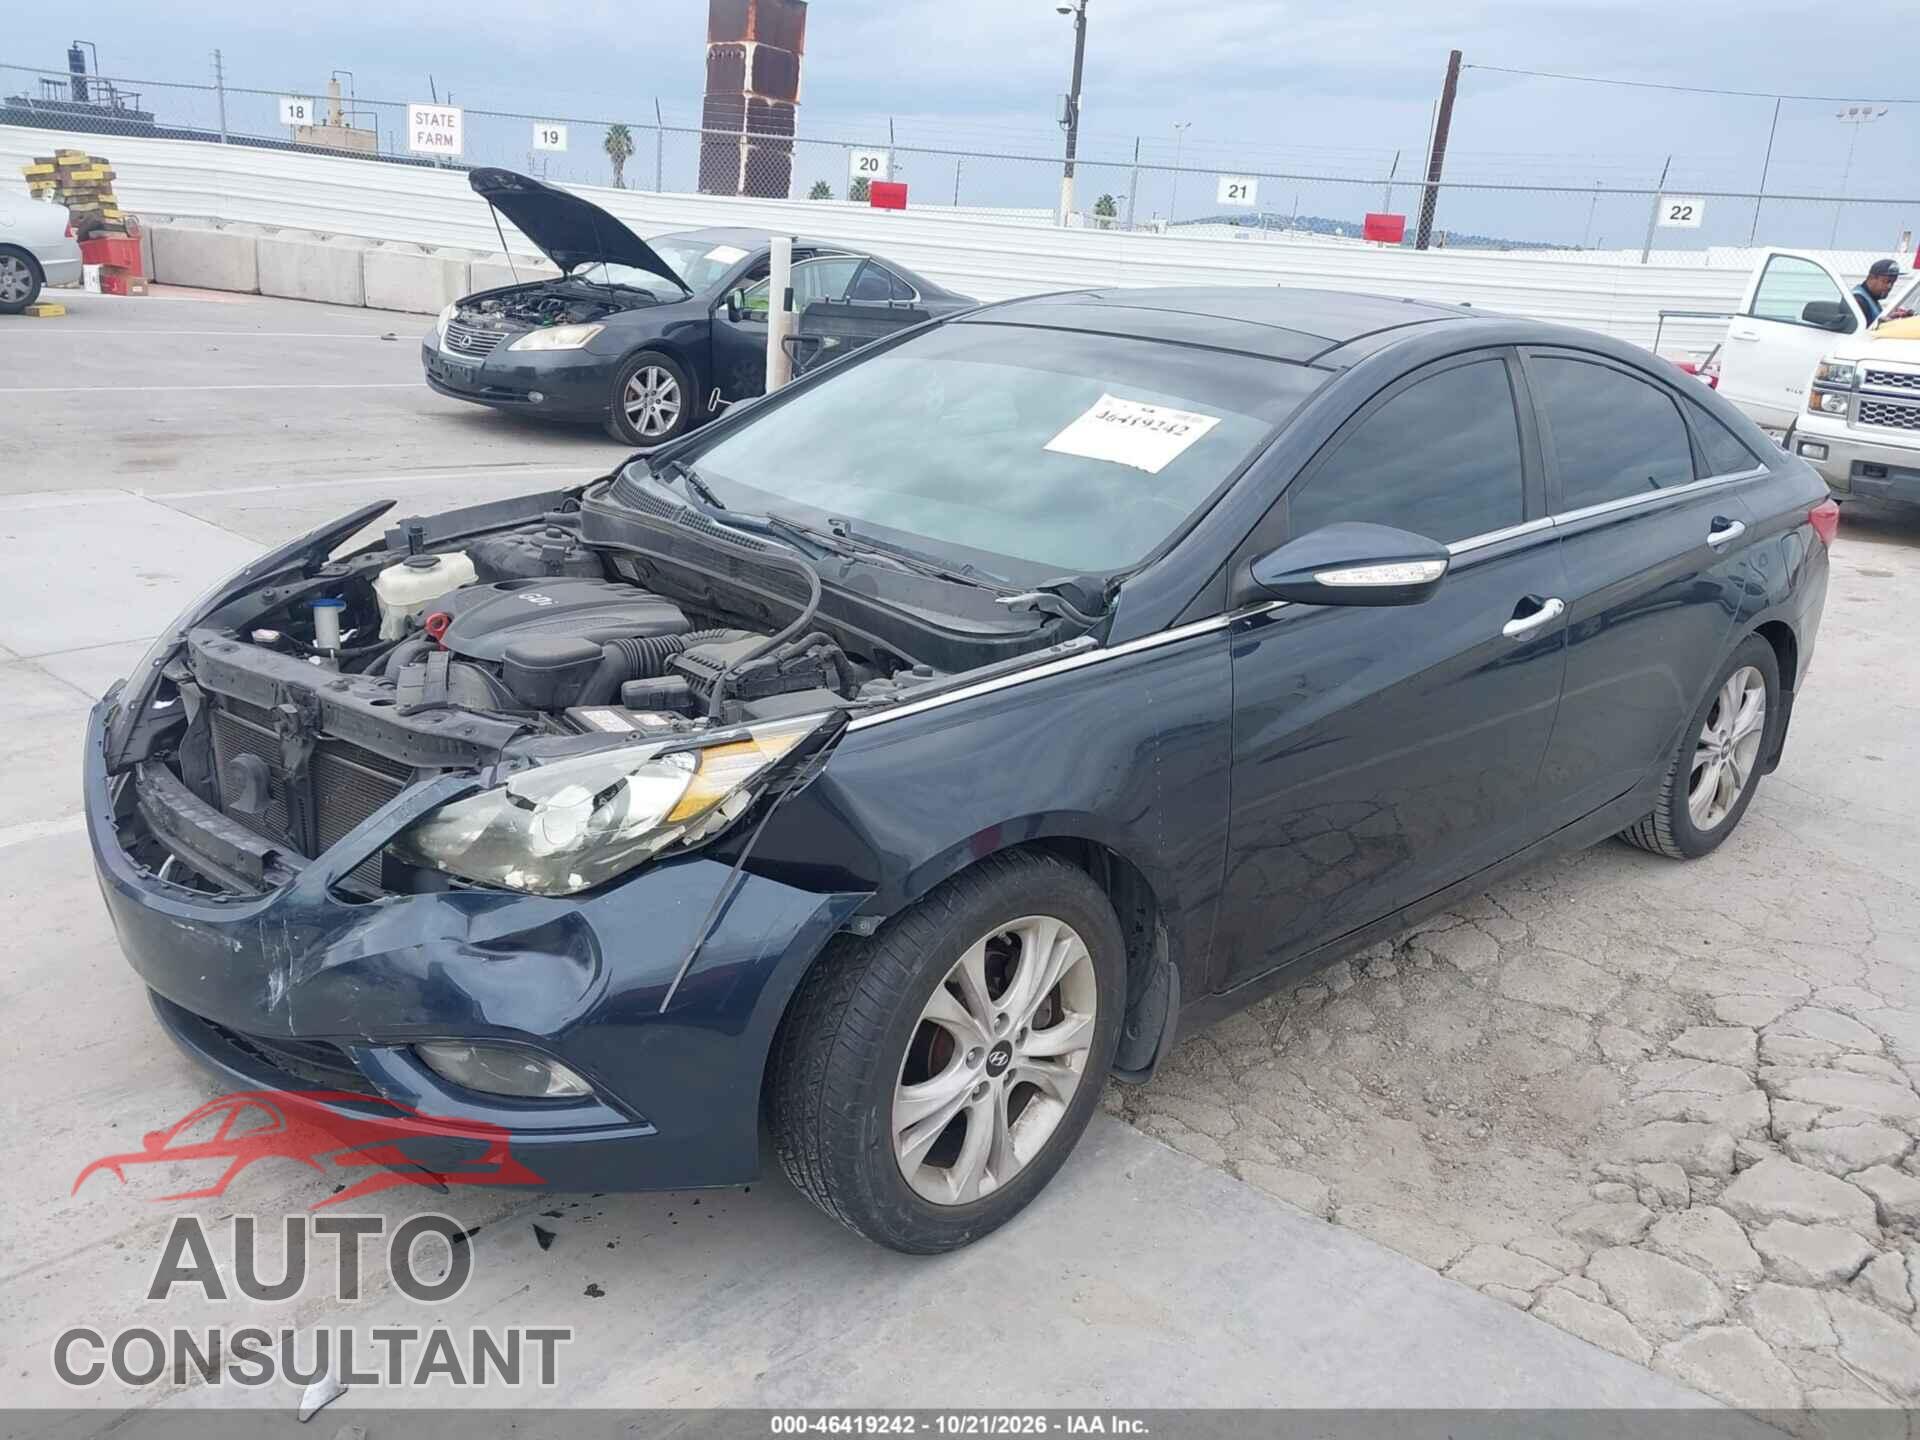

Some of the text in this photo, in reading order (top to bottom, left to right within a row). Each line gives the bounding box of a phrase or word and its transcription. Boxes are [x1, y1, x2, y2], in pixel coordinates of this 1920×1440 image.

[288, 105, 305, 119] 18
[415, 112, 456, 128] STATE
[416, 131, 454, 146] FARM
[541, 130, 559, 144] 19
[860, 157, 879, 171] 20
[1228, 184, 1247, 199] 21
[1670, 205, 1693, 220] 22
